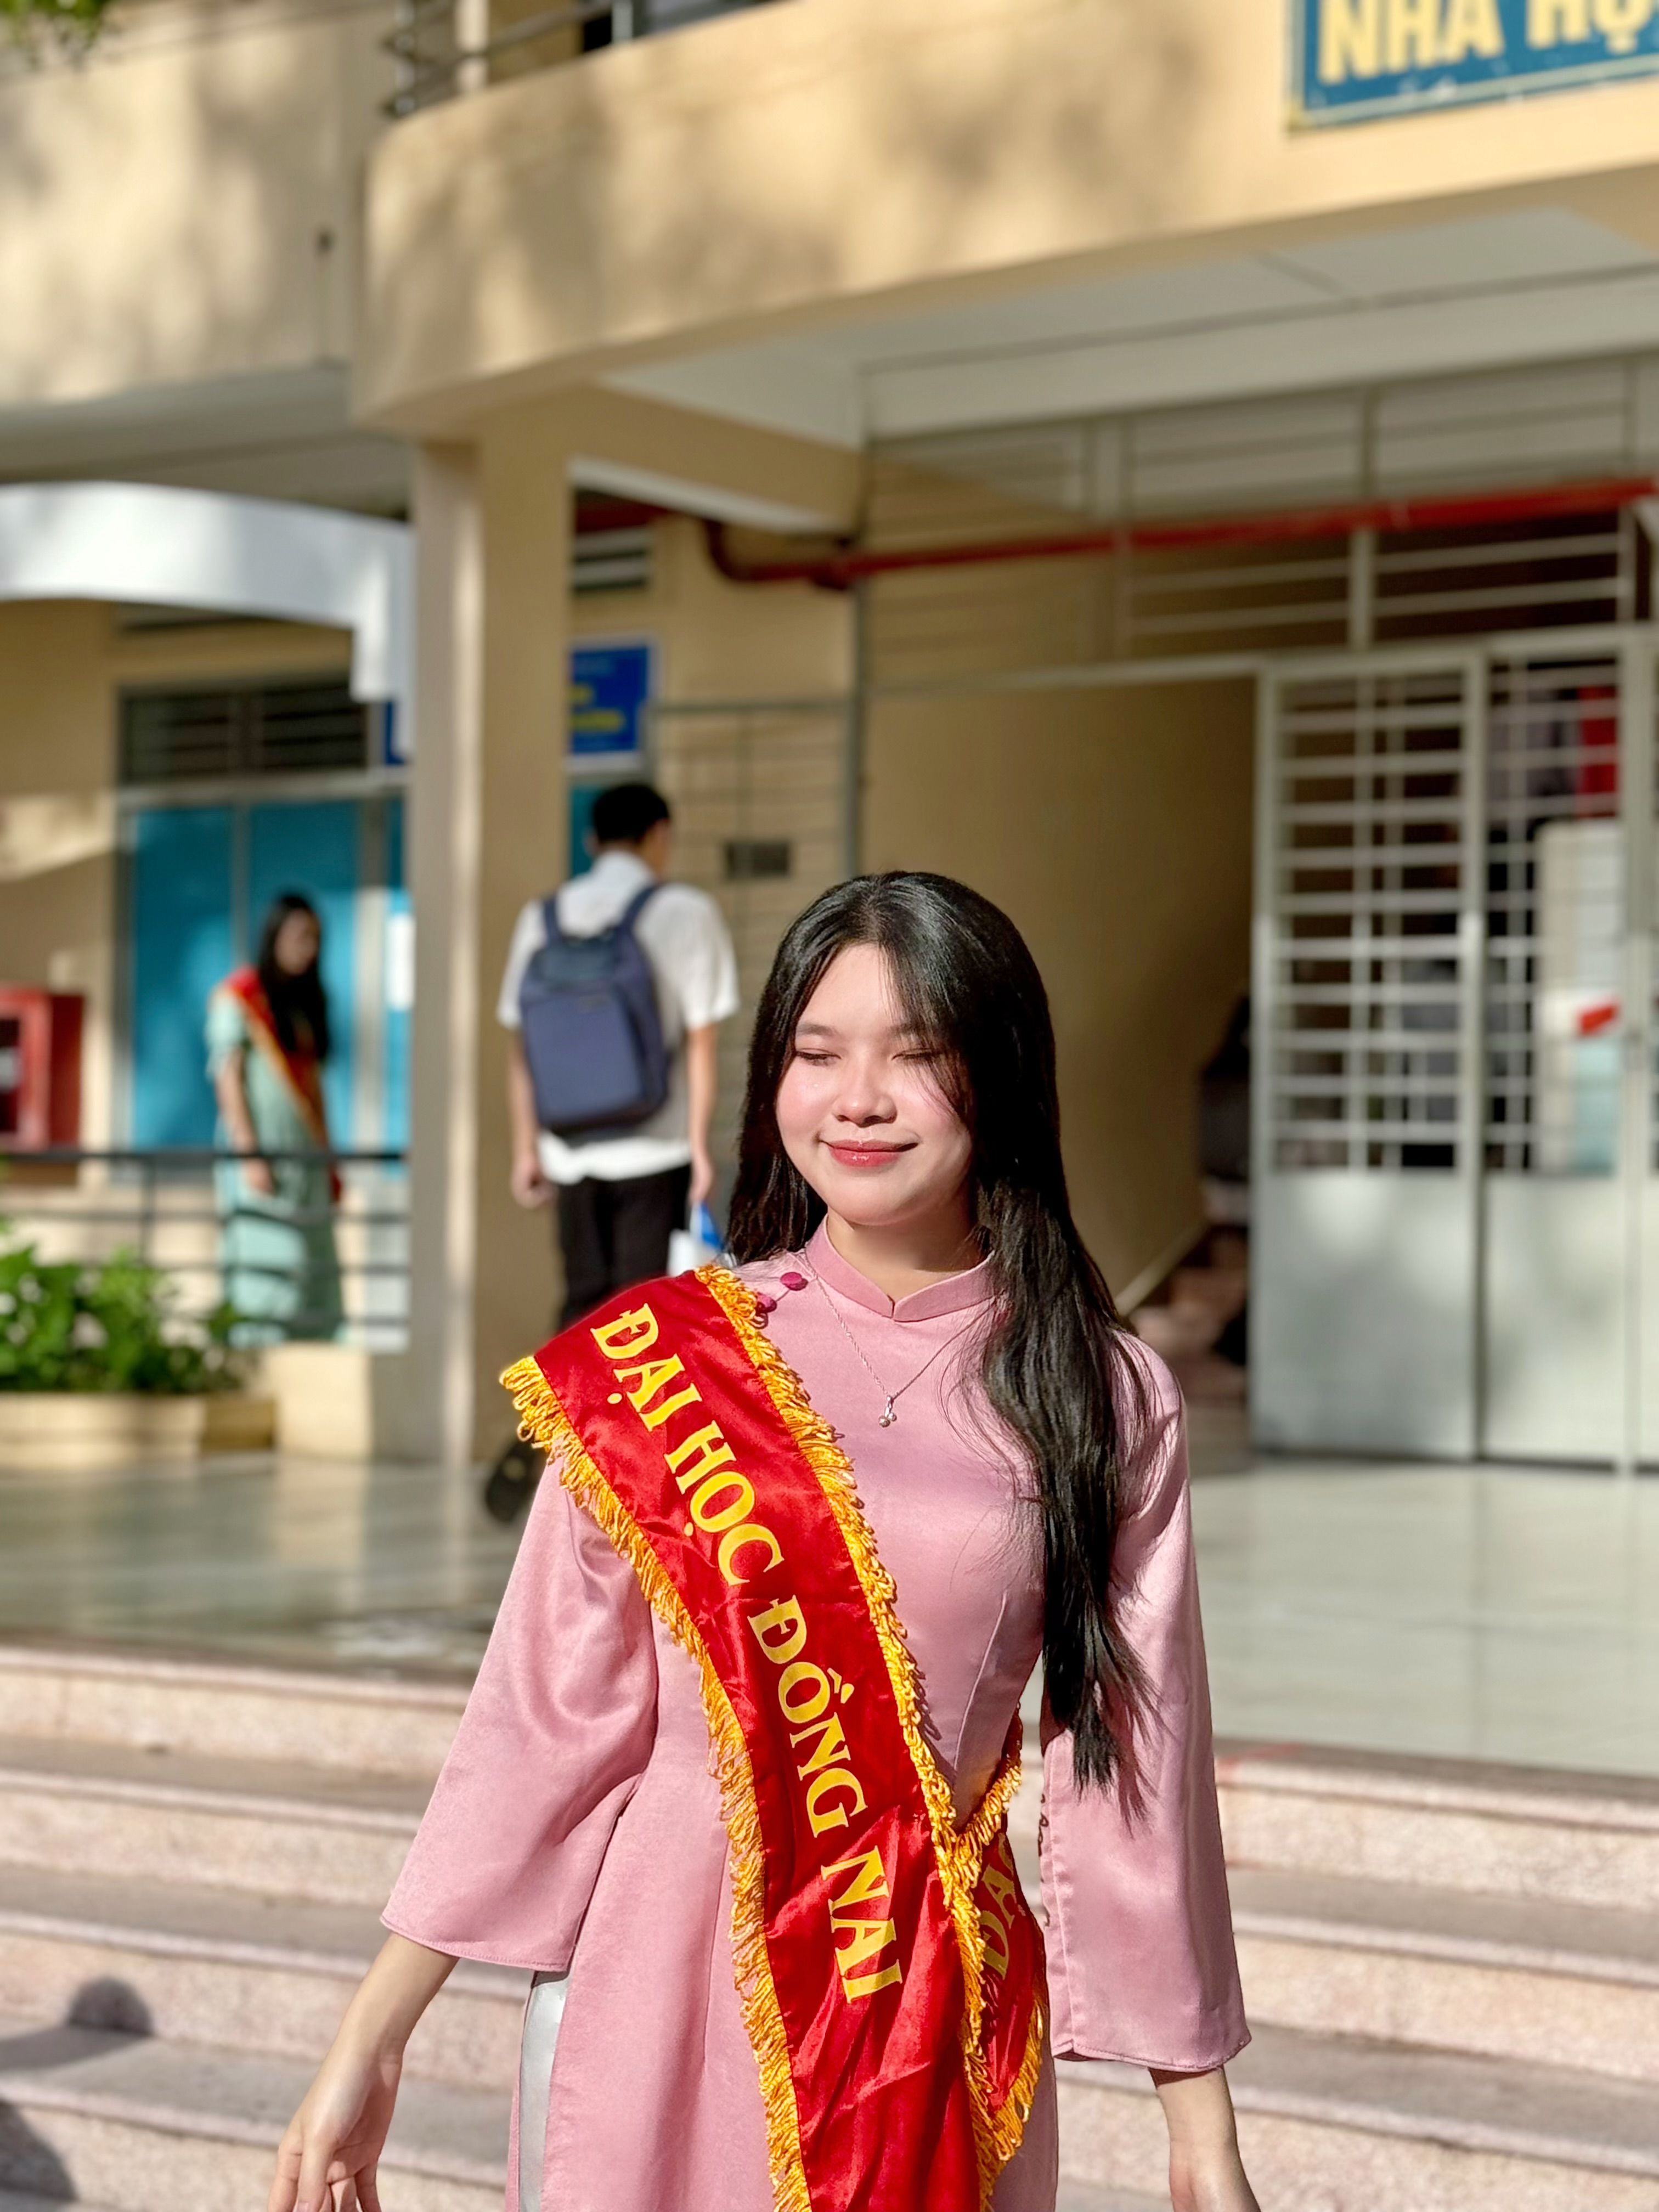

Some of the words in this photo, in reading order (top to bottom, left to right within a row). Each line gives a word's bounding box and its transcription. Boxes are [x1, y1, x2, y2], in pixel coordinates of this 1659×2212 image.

[590, 1303, 703, 1432] ĐẠI
[664, 1420, 785, 1586] HỌC
[747, 1594, 868, 1838] ĐỒNG
[821, 1845, 902, 2004] NAI
